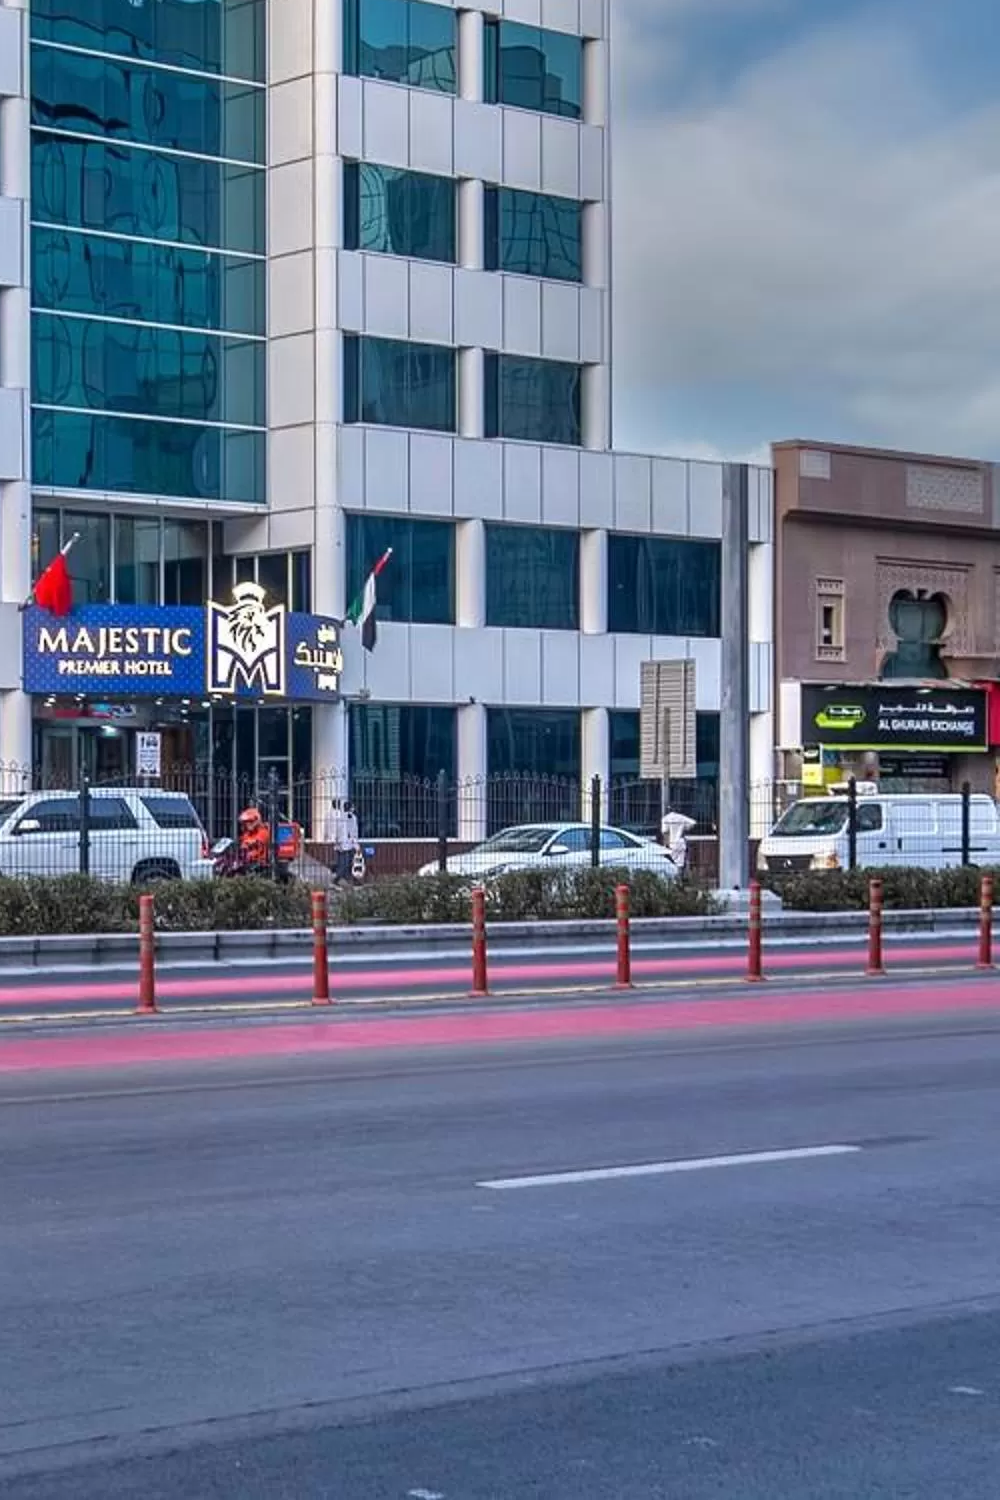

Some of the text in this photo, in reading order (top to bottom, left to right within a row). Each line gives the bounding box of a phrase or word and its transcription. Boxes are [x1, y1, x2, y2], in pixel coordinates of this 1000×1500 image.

[38, 627, 192, 658] MAJESTIC
[58, 660, 172, 675] PREMIER HOTEL
